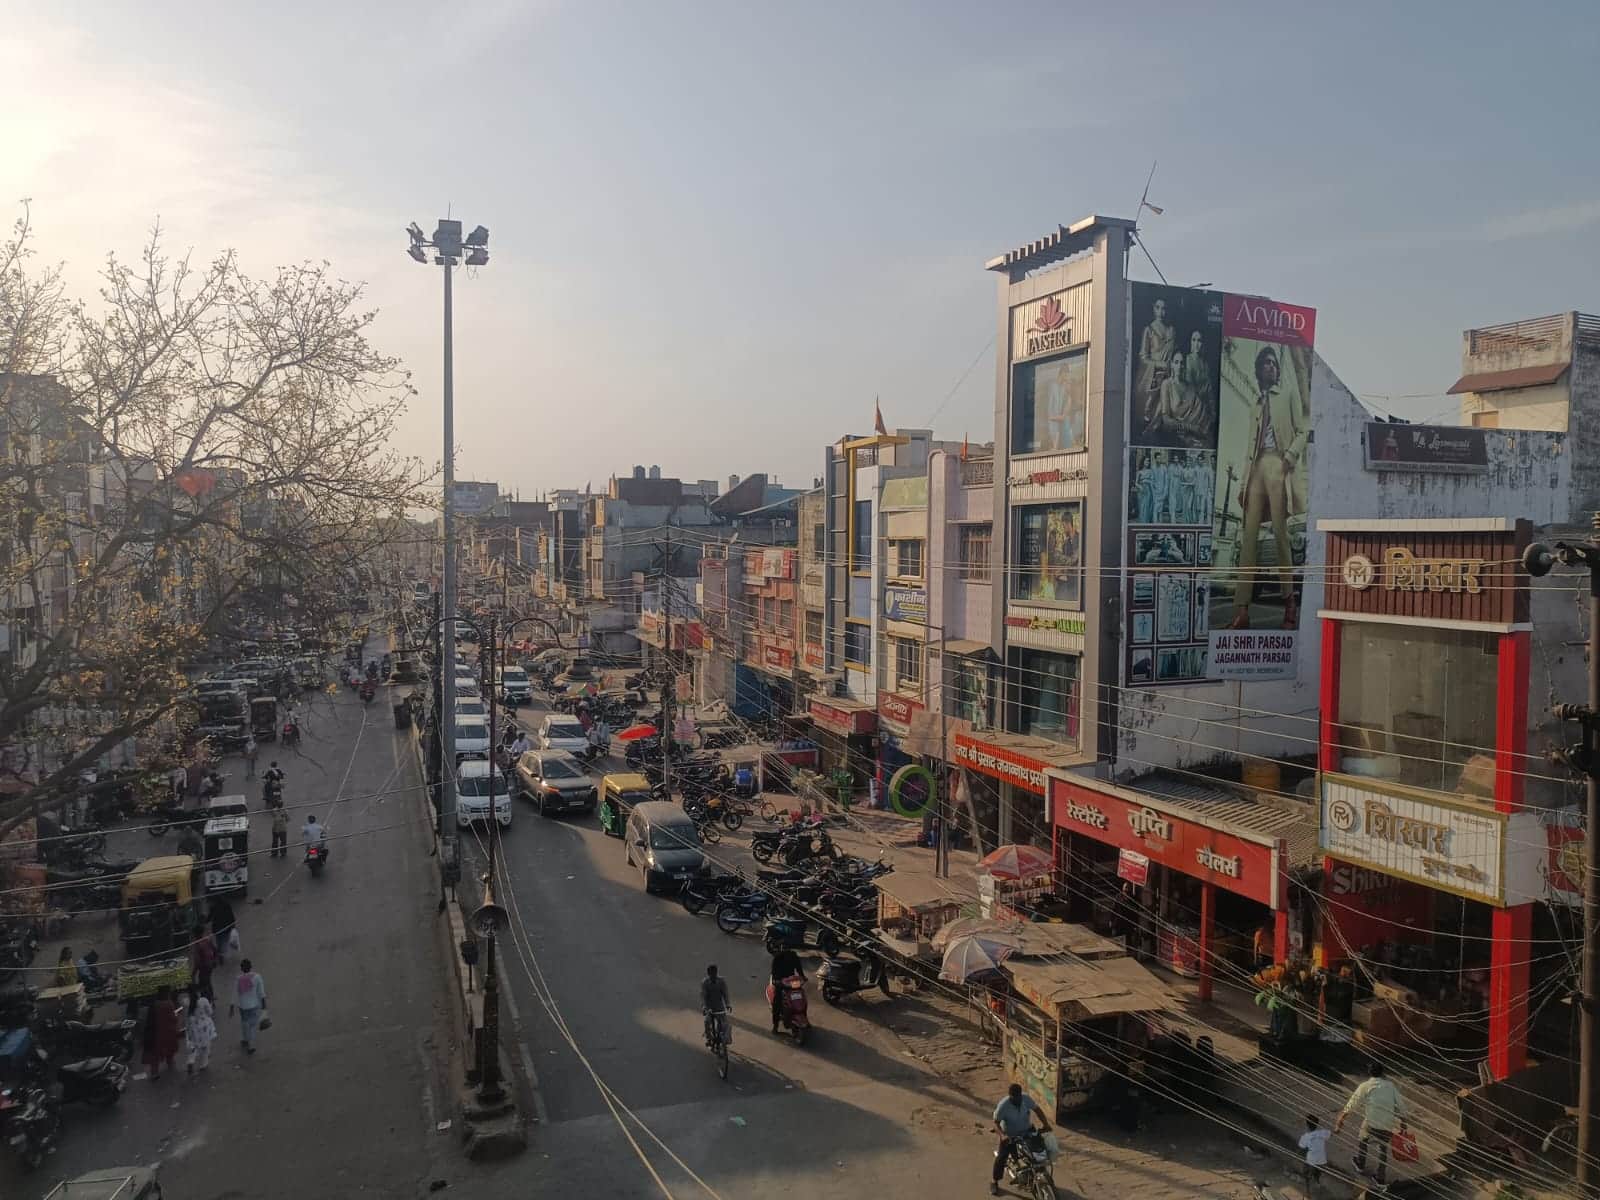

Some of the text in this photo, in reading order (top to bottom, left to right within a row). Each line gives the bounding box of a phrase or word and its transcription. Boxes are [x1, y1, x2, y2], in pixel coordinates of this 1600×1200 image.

[1216, 636, 1293, 649] JAI SHRI PARSAD
[1215, 652, 1291, 664] JAGANNATH PARSAD
